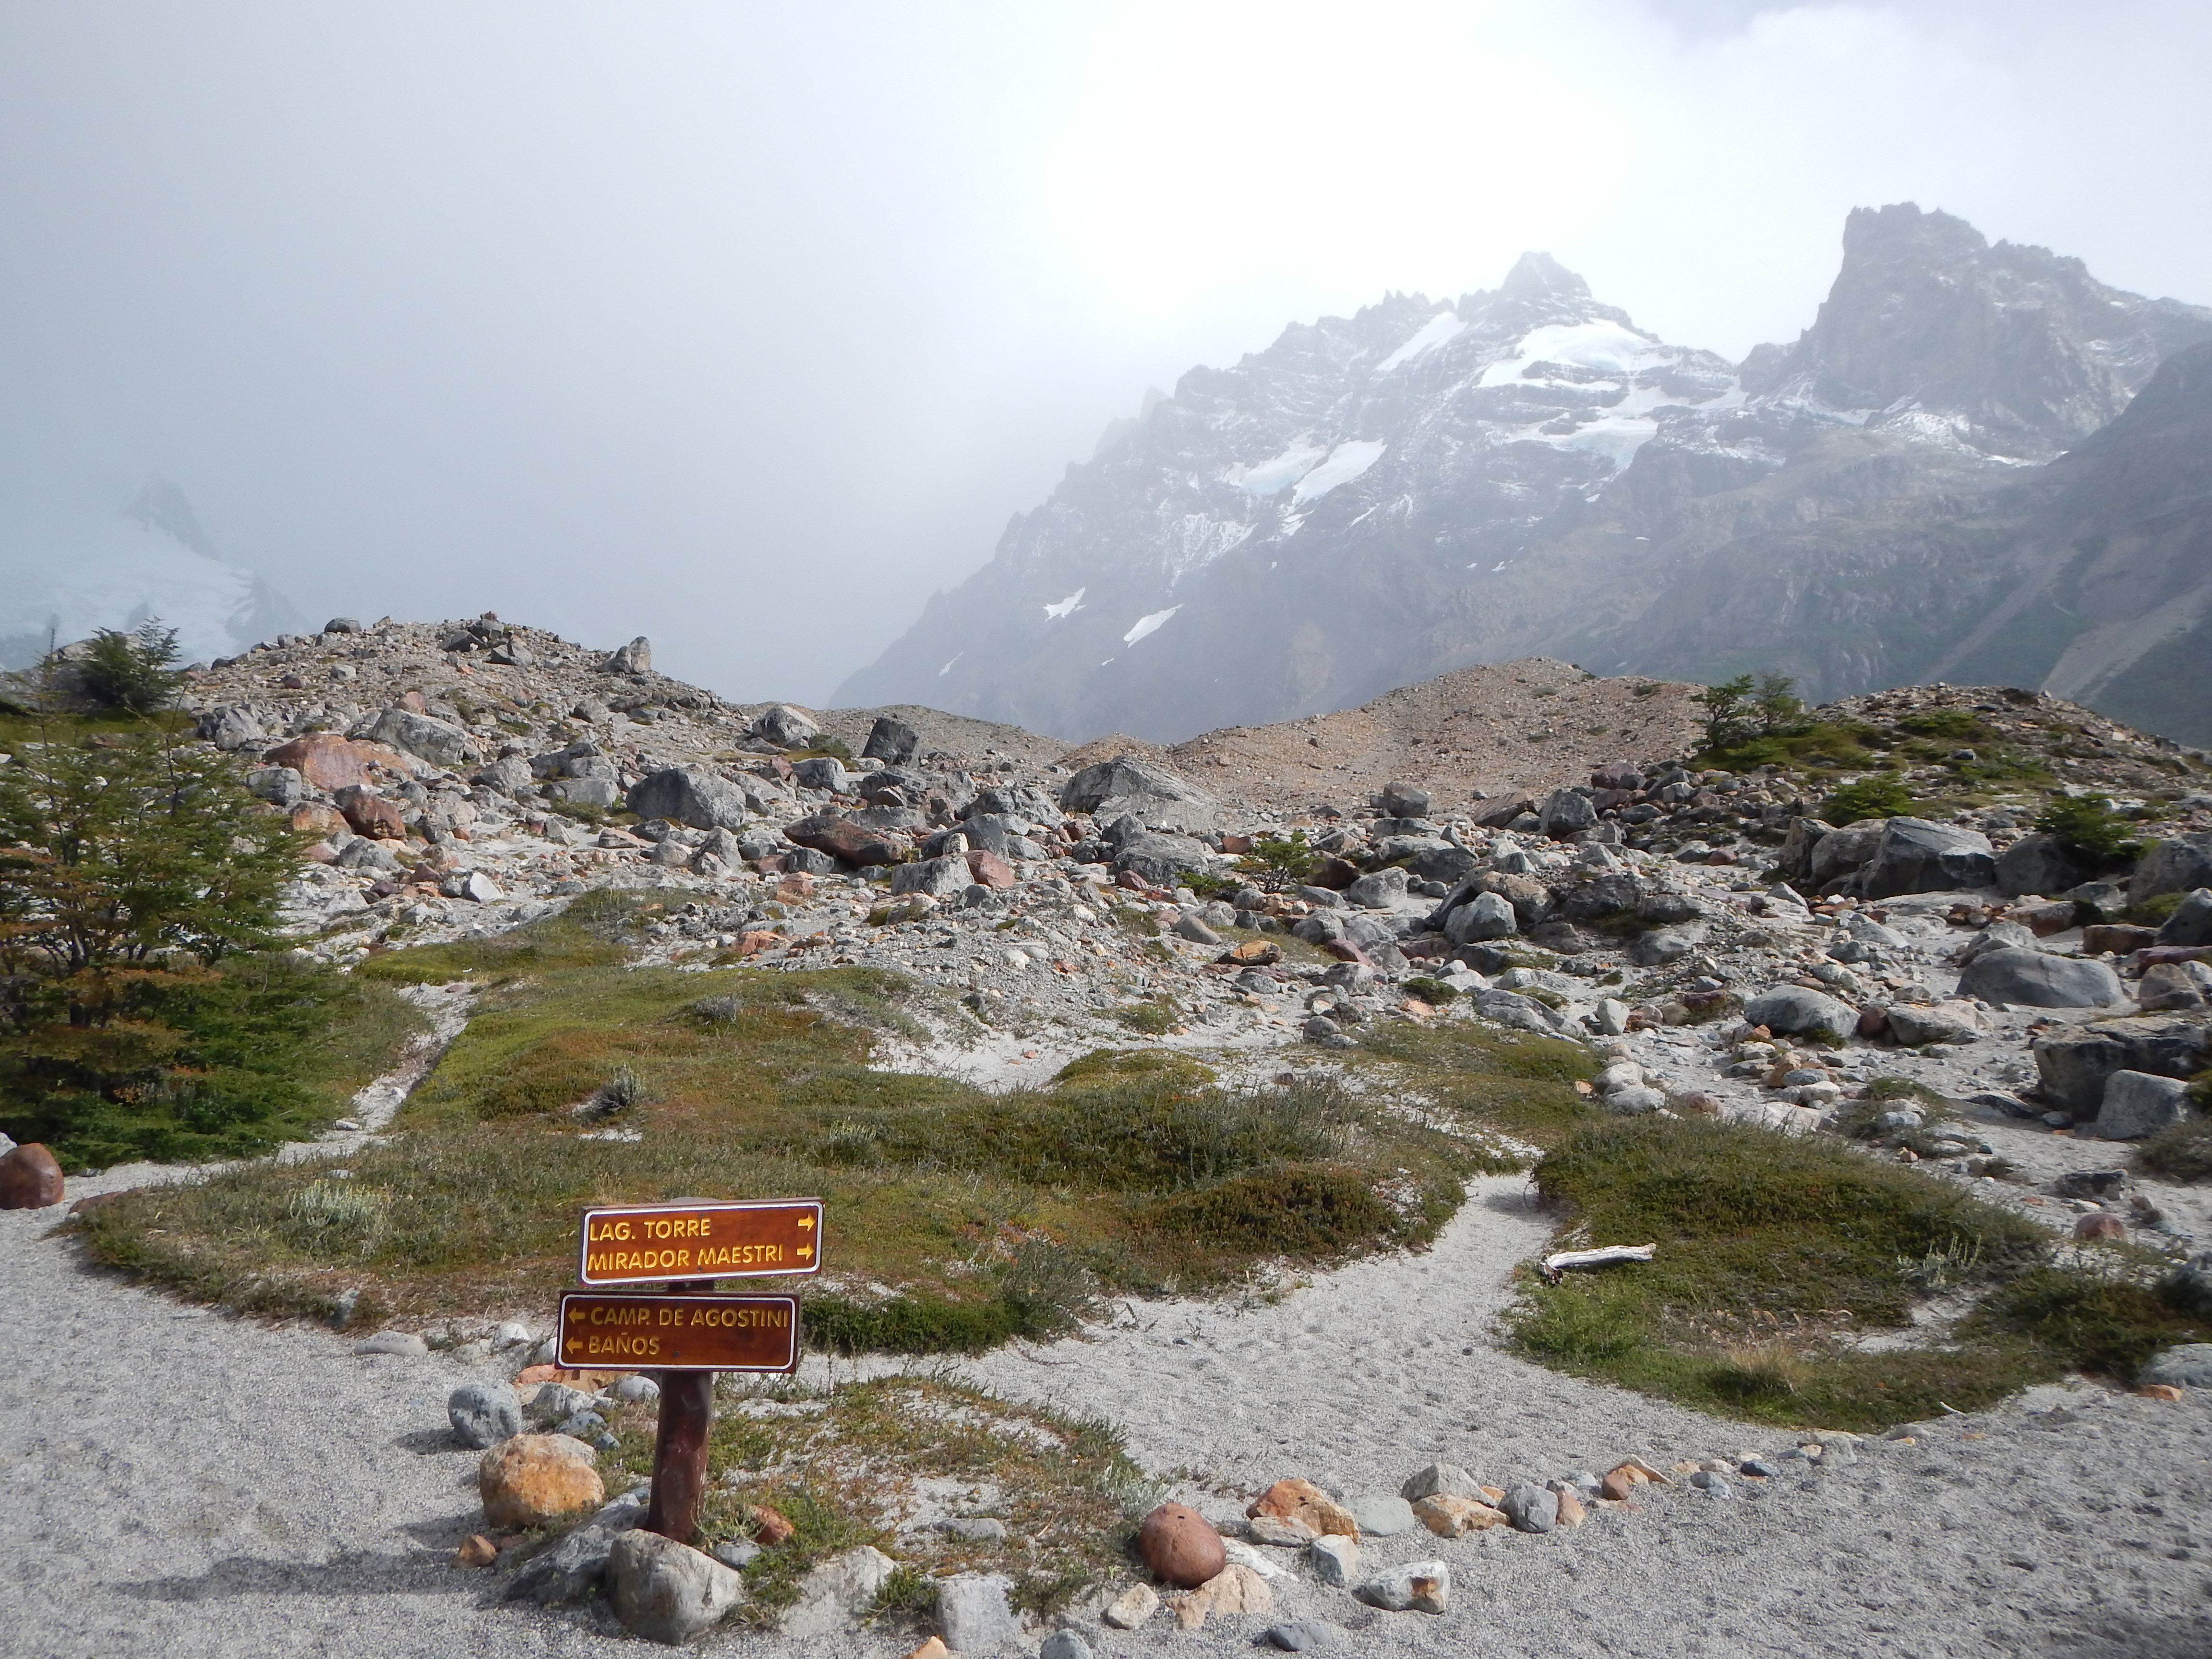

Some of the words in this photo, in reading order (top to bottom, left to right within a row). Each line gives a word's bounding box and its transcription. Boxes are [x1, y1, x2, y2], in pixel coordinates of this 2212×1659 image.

[589, 1222, 636, 1241] LAG.
[644, 1218, 710, 1238] TORRE
[587, 1249, 690, 1271] MIRADOR
[697, 1244, 783, 1265] MAESTRI
[591, 1307, 650, 1325] CAMP.
[659, 1309, 684, 1325] DE
[691, 1308, 788, 1327] AGOSTINI
[589, 1332, 660, 1355] BAÑOS
